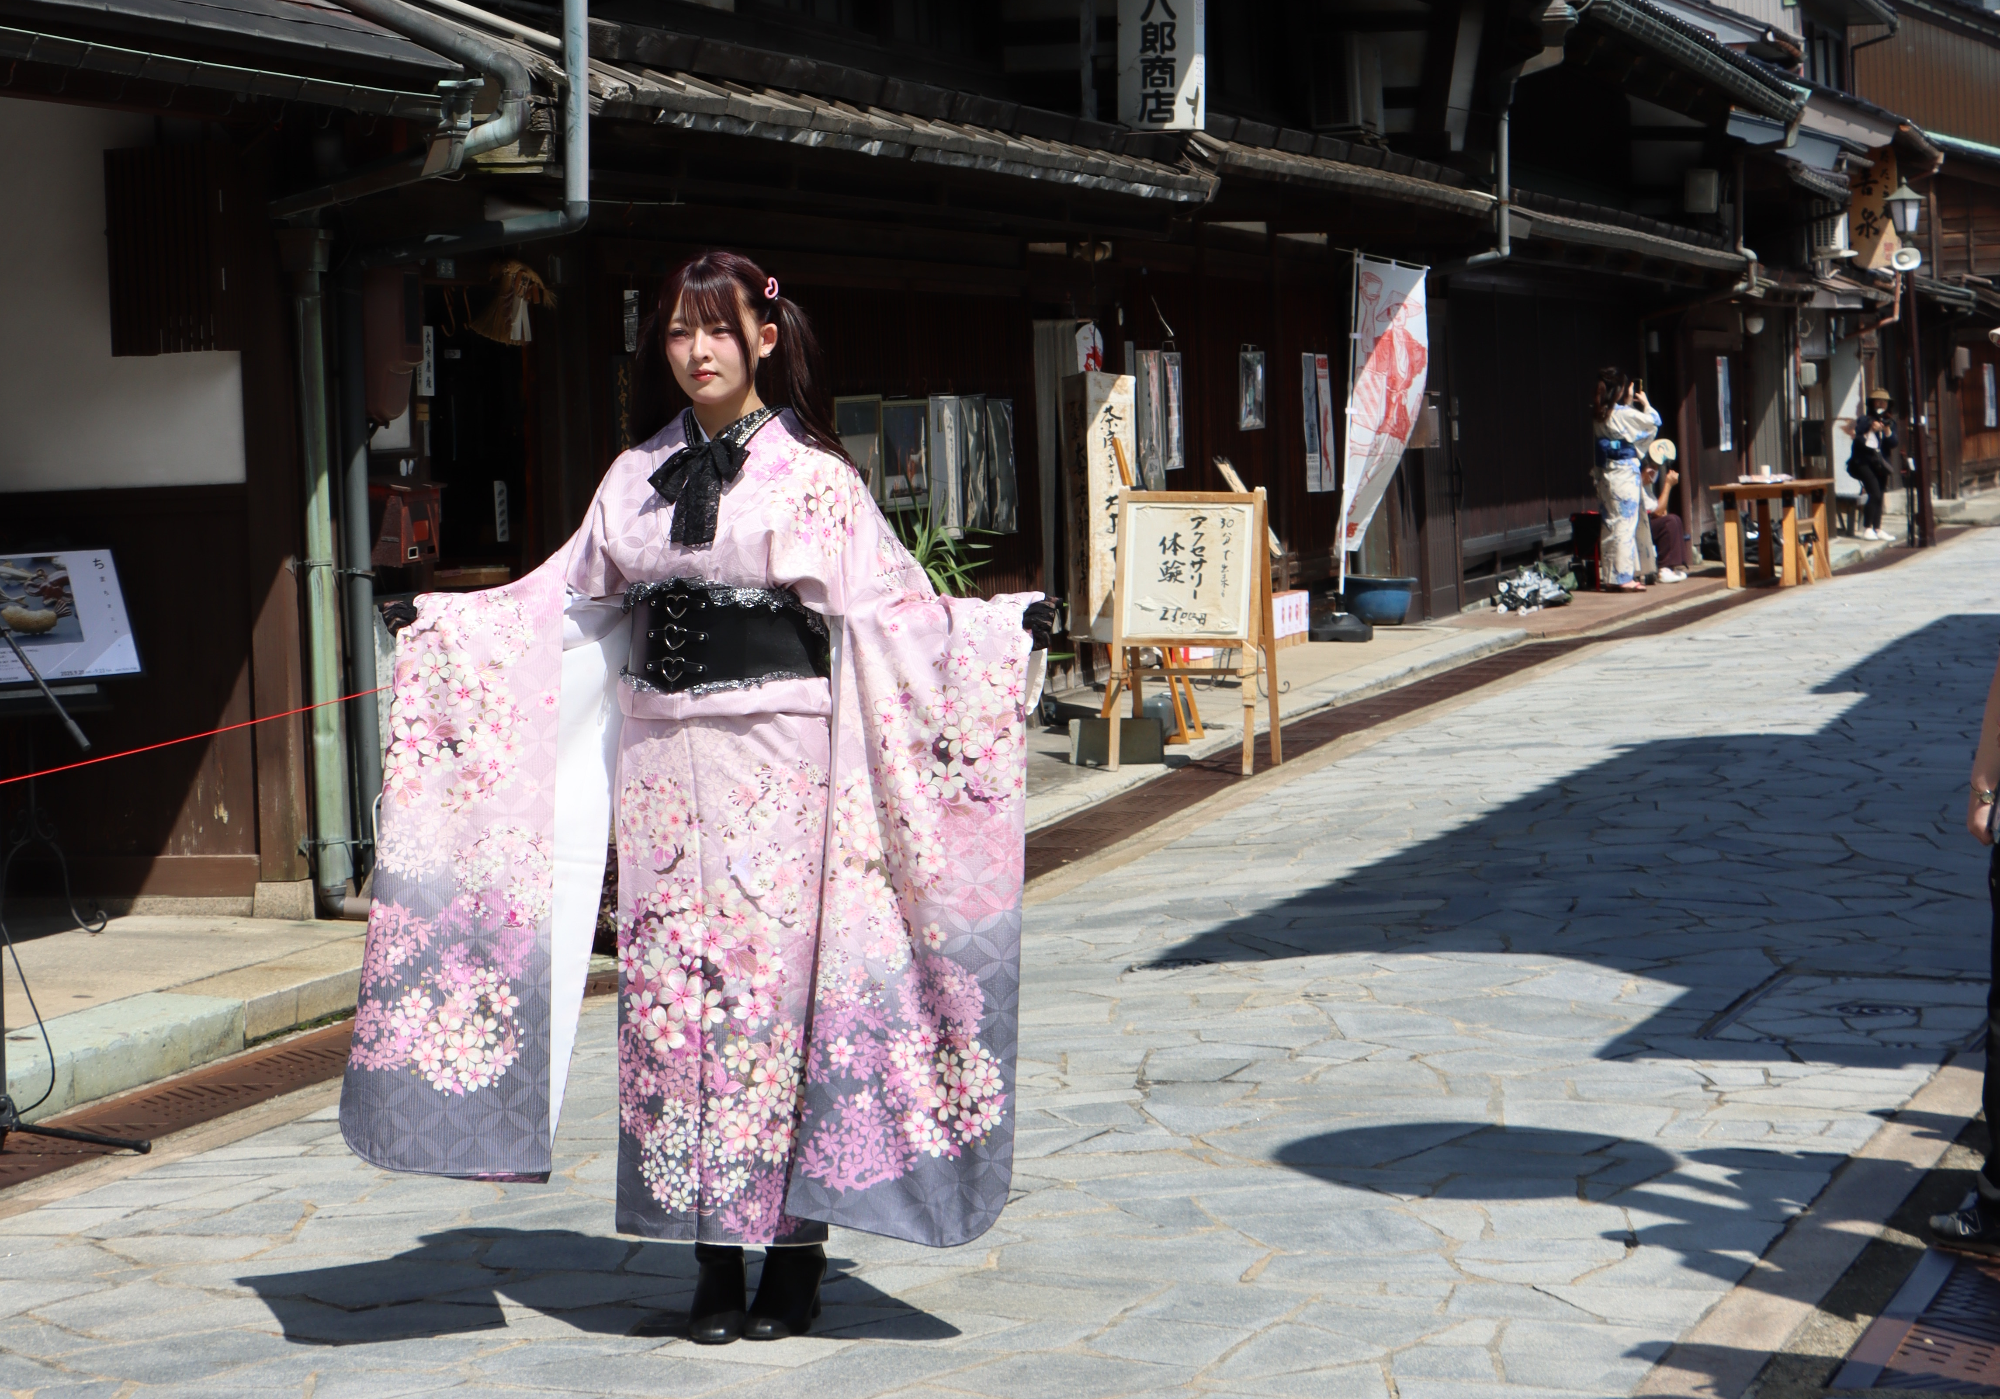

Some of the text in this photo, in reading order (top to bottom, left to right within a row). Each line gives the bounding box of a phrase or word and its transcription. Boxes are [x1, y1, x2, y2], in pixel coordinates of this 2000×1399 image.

[1139, 0, 1176, 123] 八郎商店
[1157, 531, 1186, 584] 体験
[1190, 516, 1208, 600] アクセサリー
